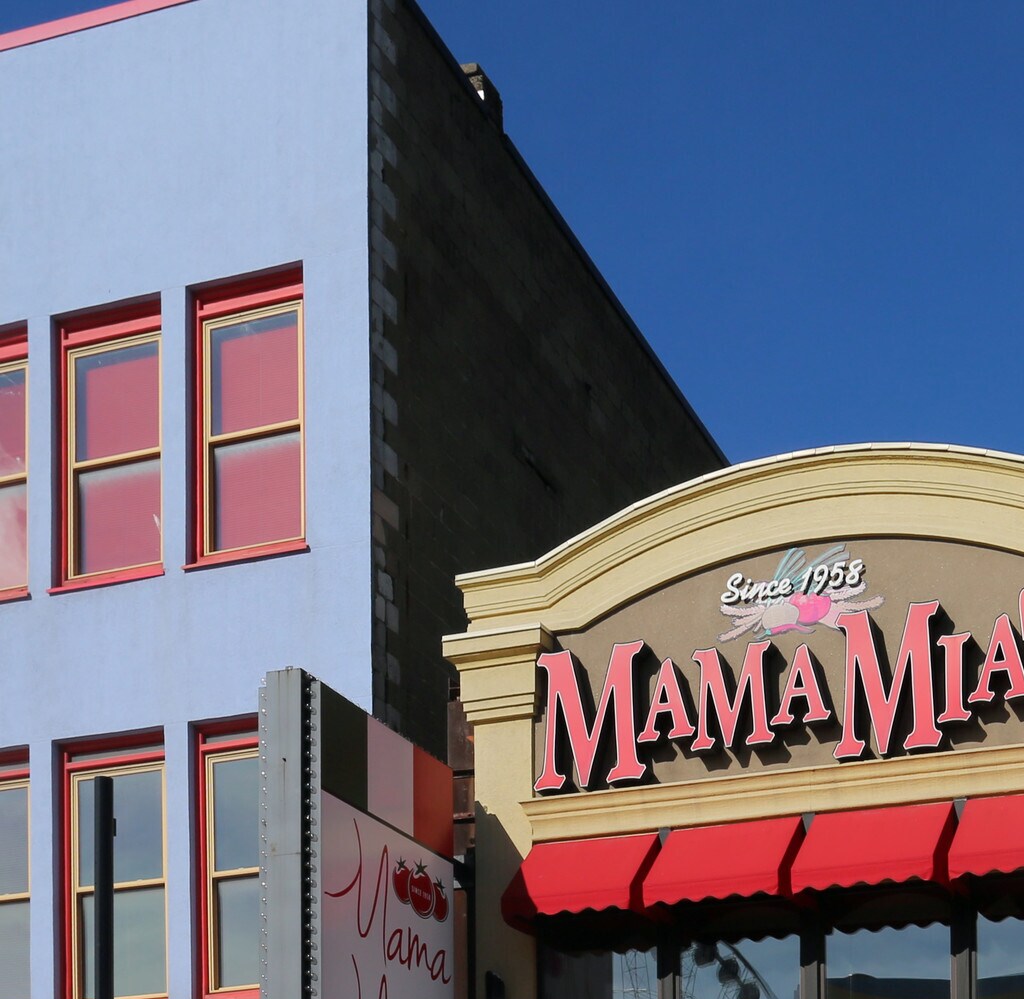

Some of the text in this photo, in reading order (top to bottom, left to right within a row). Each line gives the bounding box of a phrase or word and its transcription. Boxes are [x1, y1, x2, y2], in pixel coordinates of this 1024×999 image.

[720, 559, 864, 603] Since 1958
[324, 818, 452, 985] Mama
